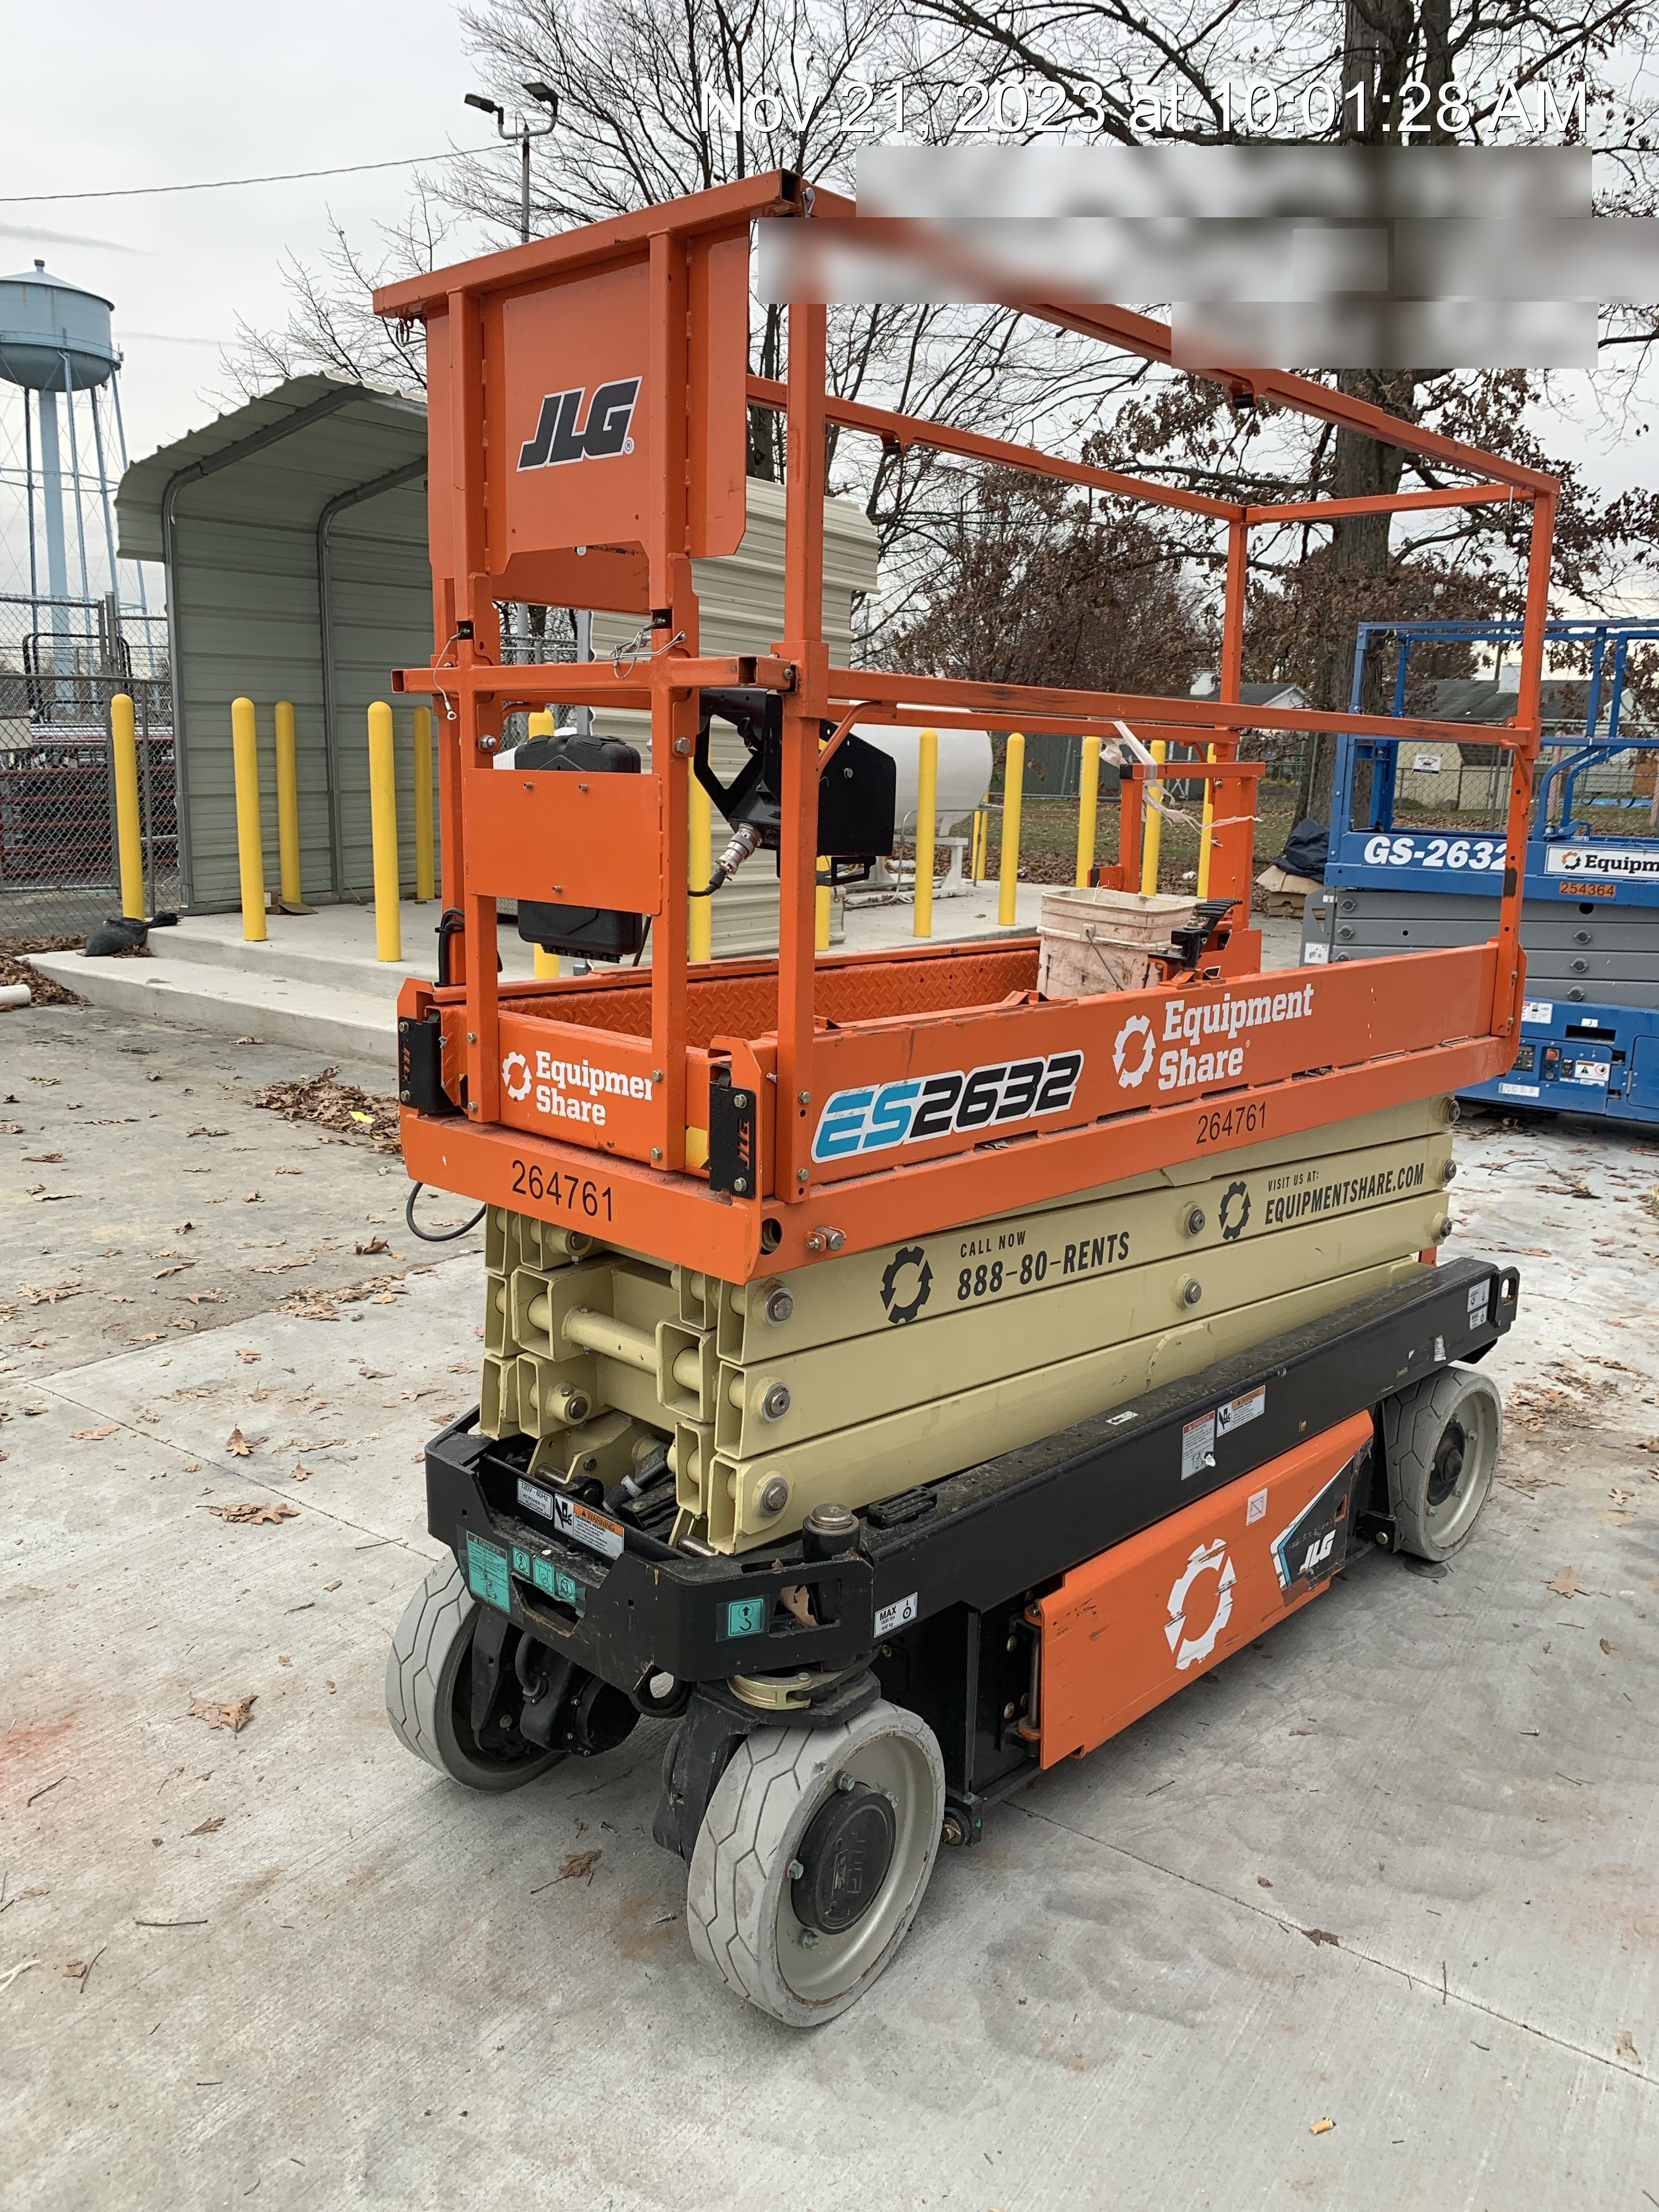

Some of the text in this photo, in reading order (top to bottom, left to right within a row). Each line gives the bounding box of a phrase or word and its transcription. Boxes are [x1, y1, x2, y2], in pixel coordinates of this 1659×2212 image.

[1560, 882, 1615, 897] 254364
[1162, 983, 1314, 1046] Equipment
[1158, 1047, 1244, 1091] Share
[535, 1084, 606, 1126] Share
[812, 1051, 1084, 1162] ES2632
[1196, 1102, 1267, 1144] 264761
[512, 1160, 612, 1222] 264761
[1265, 1163, 1425, 1225] EQUIPMENTSHARE.COM
[1268, 1170, 1319, 1192] VISIT US AT:
[960, 1231, 1026, 1258] CALL NOW
[957, 1231, 1130, 1301] 888-80-RENTS
[521, 1482, 533, 1493] 120V
[536, 1490, 549, 1502] 60Hz
[587, 1511, 615, 1532] WARNING
[479, 1538, 501, 1556] DANGER
[1299, 1529, 1336, 1575] JLG
[879, 1605, 896, 1621] MAX
